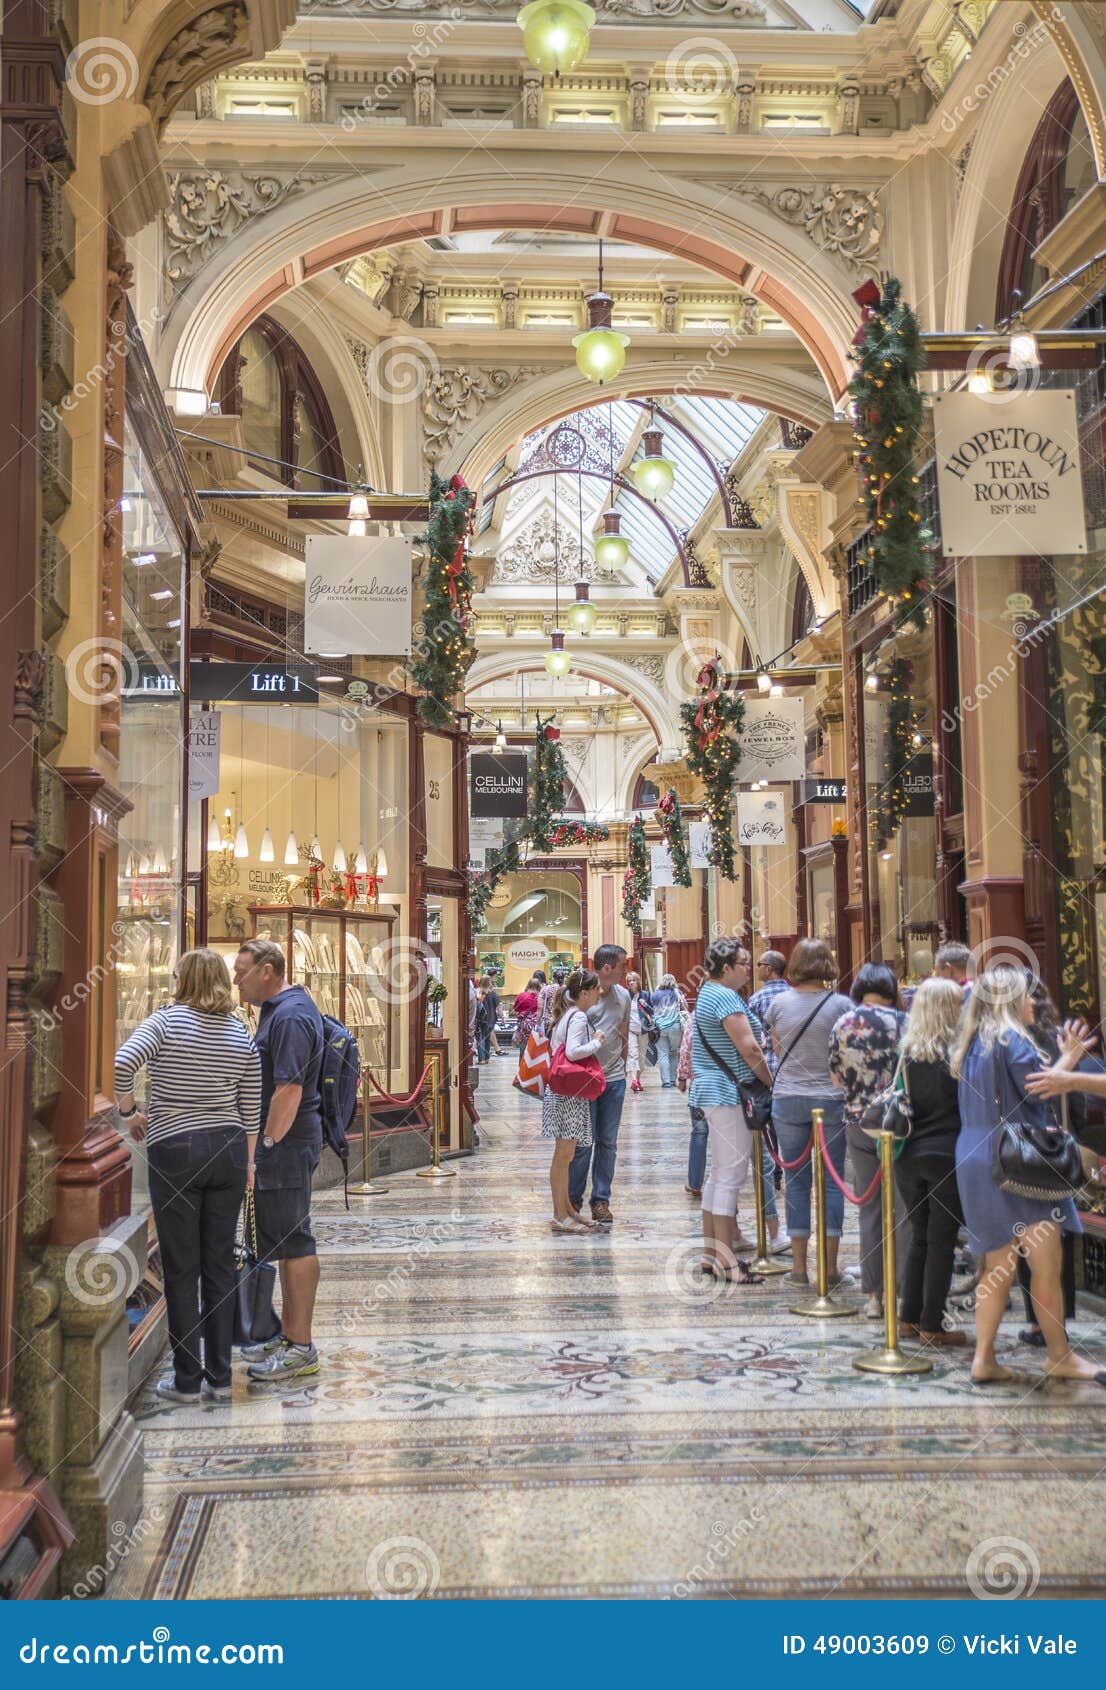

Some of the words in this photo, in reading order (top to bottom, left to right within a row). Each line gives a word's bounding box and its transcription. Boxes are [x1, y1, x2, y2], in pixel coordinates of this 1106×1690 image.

[944, 427, 1076, 480] HOPETOUN
[986, 461, 1032, 479] TEA
[975, 482, 1050, 501] ROOMS
[991, 504, 1011, 514] EST
[251, 674, 286, 691] Lift
[293, 675, 301, 691] 1
[749, 723, 761, 735] THE
[763, 722, 791, 733] FRENCH
[743, 735, 795, 743] JEWELBOX
[475, 776, 524, 787] CELLINI
[429, 780, 440, 800] 25
[816, 785, 839, 797] Lift
[511, 950, 546, 958] HAIGH'S
